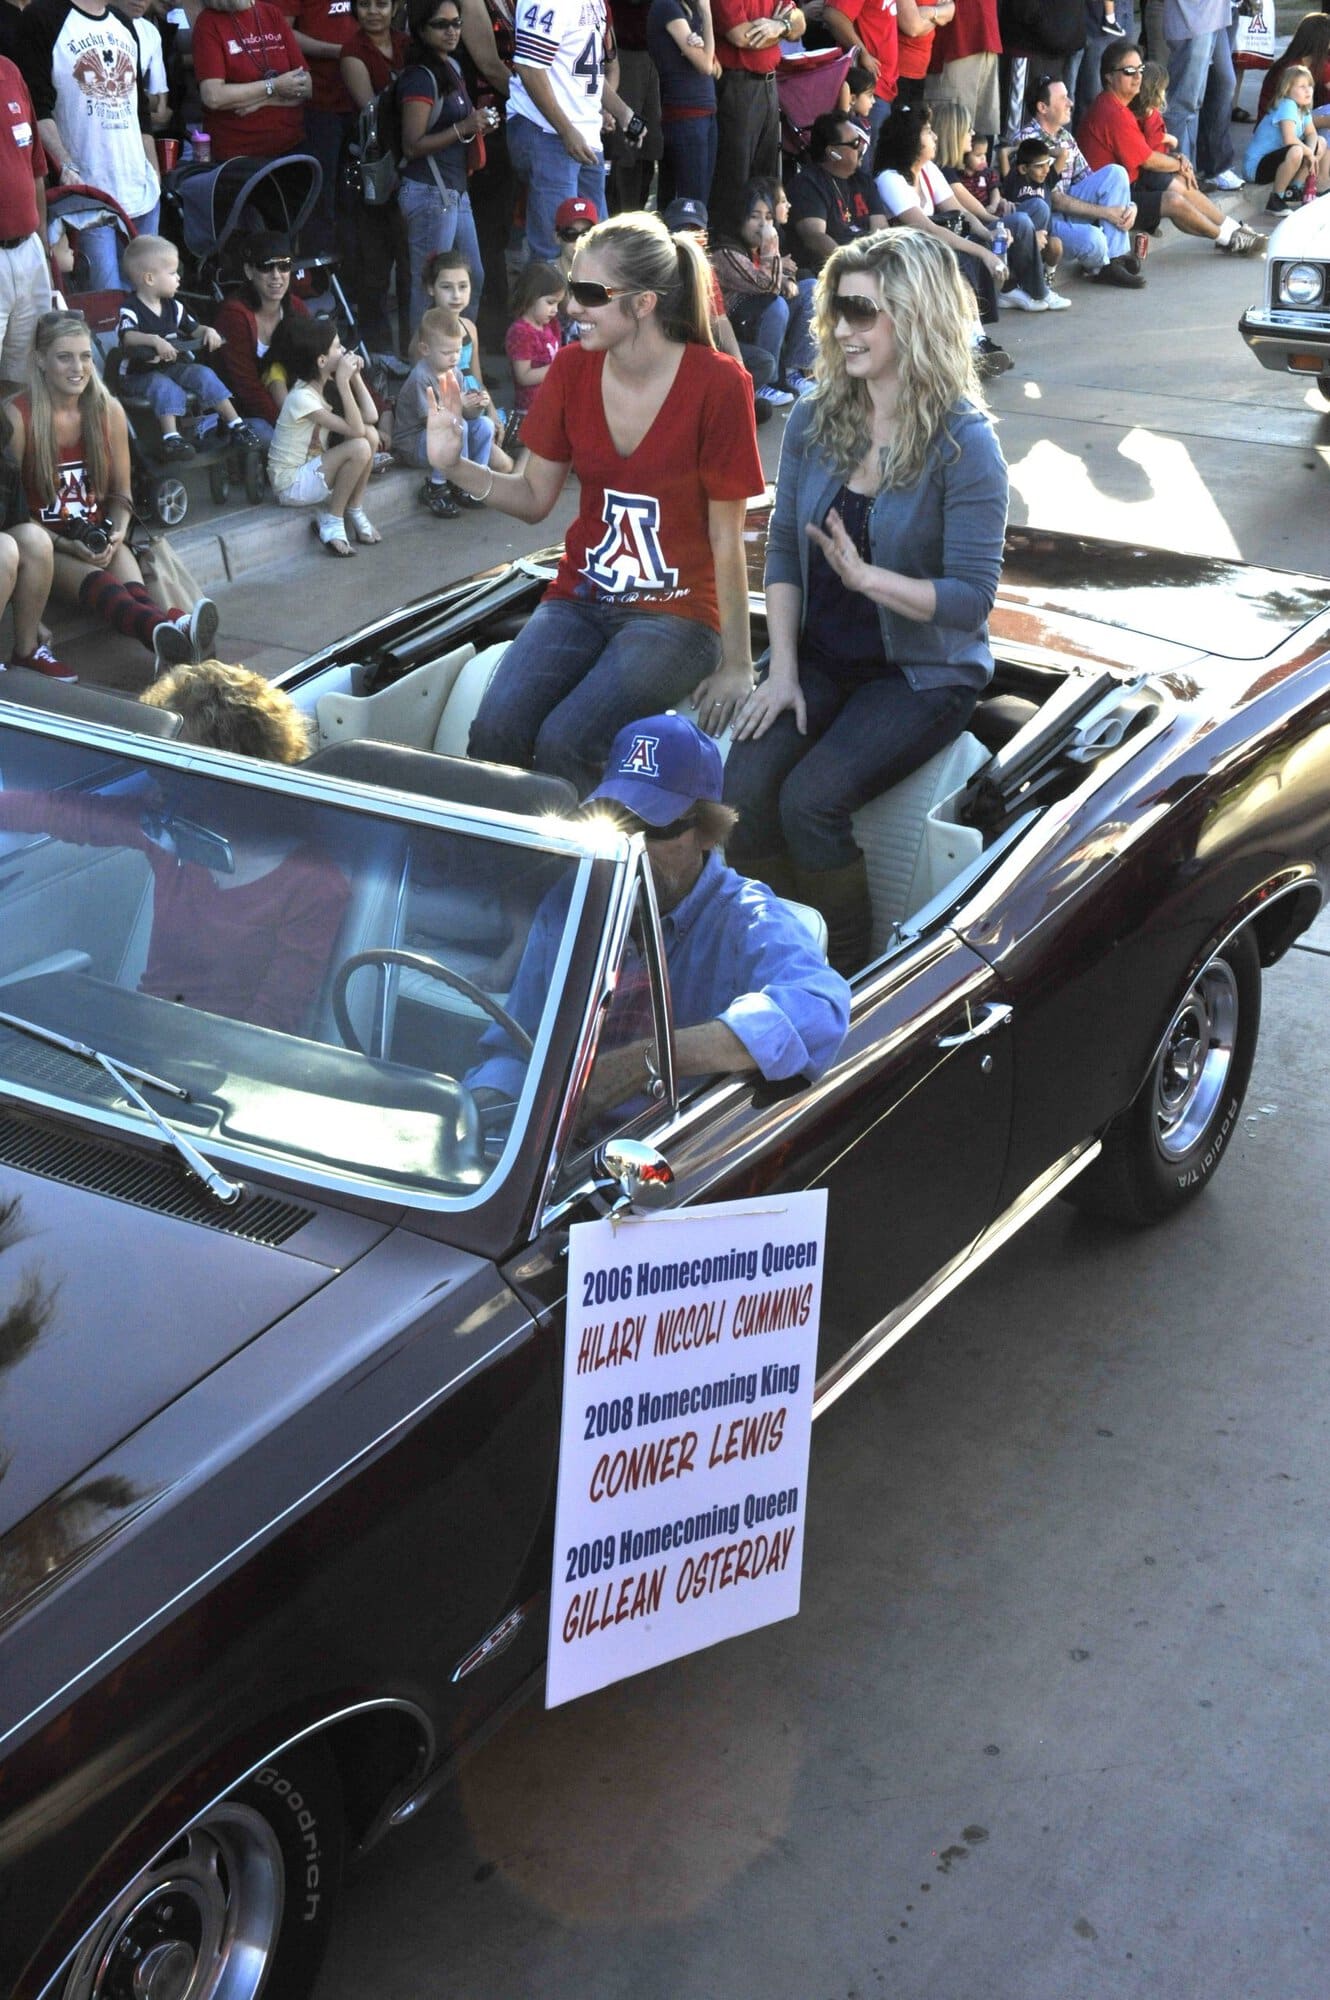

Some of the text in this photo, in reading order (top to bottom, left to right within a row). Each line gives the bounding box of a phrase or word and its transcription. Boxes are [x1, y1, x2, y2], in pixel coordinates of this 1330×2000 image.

[67, 32, 104, 55] Lucky
[524, 4, 555, 34] 44
[577, 488, 679, 593] A
[618, 735, 660, 777] A
[582, 1240, 818, 1307] 2006 Homecoming Queen
[577, 1282, 813, 1375] HILARY NICCOLI CUMMINS
[583, 1363, 801, 1441] 2008 Homecoming King
[589, 1407, 787, 1503] CONNER LEWIS
[565, 1487, 798, 1583] 2009 Homecoming Queen
[562, 1525, 796, 1644] GILLEAN OSTERDAY
[254, 1766, 322, 1922] Goodrich
